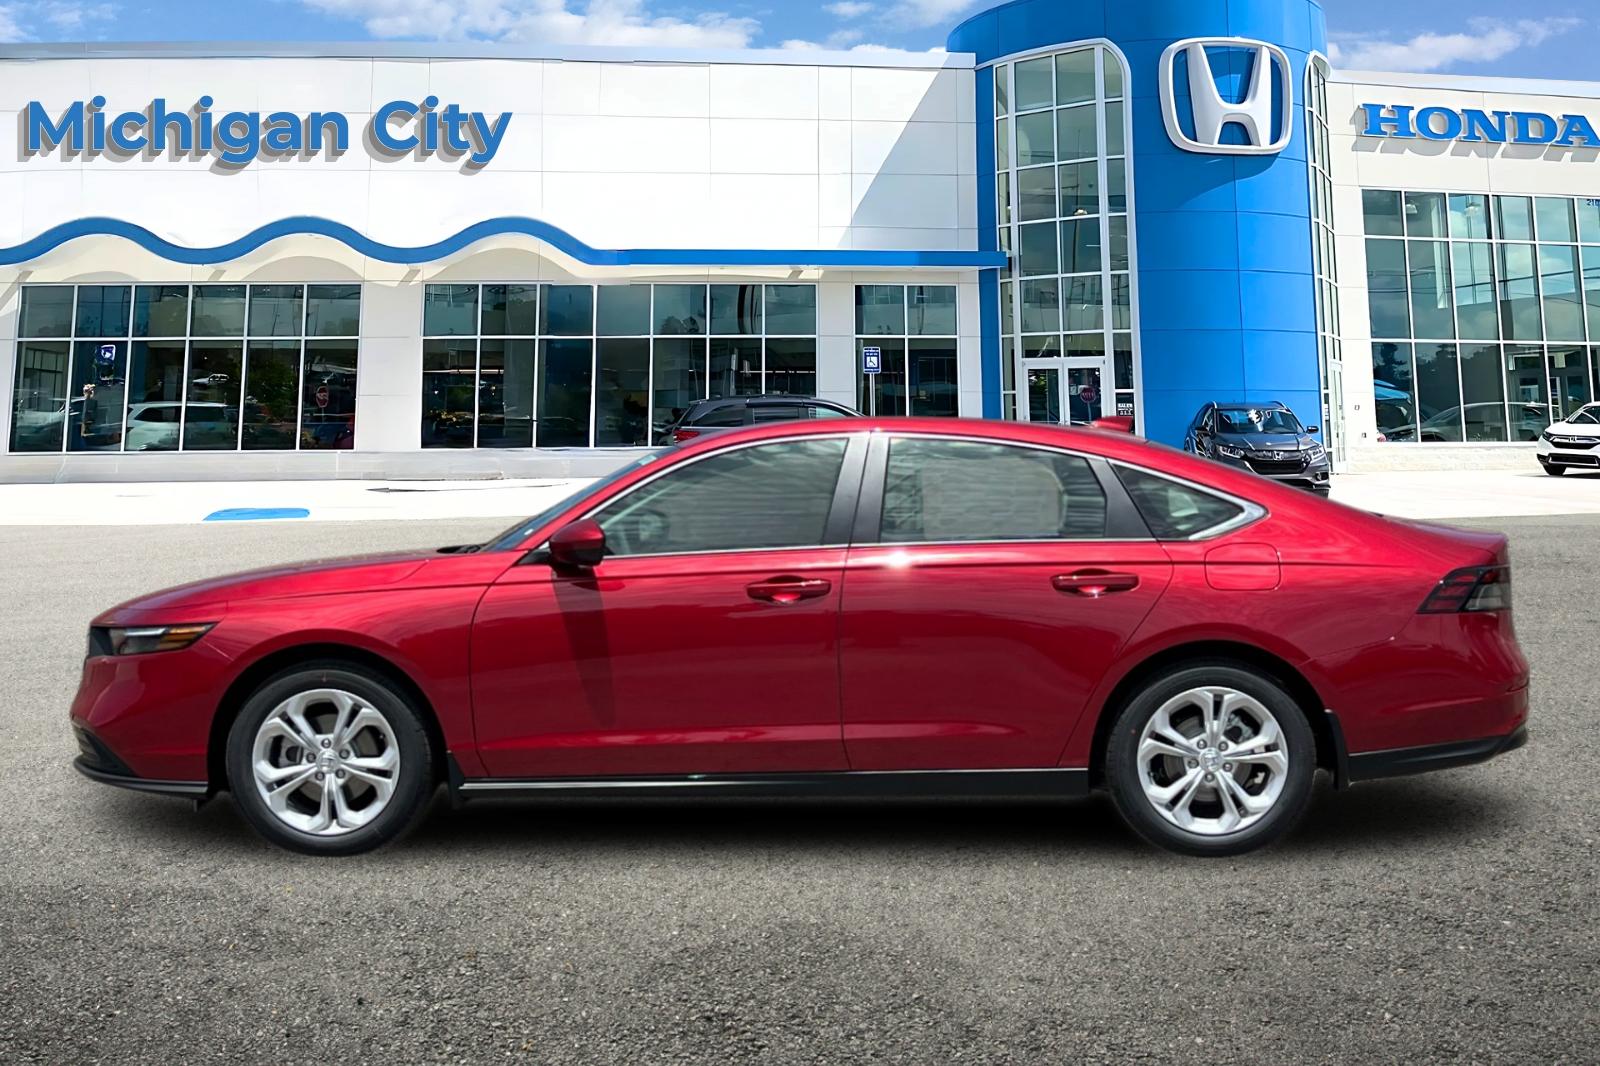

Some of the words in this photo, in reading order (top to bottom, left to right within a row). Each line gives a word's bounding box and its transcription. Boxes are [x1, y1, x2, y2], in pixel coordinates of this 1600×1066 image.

[28, 95, 349, 164] Michigan
[373, 95, 513, 164] City
[1361, 102, 1600, 148] HONDA
